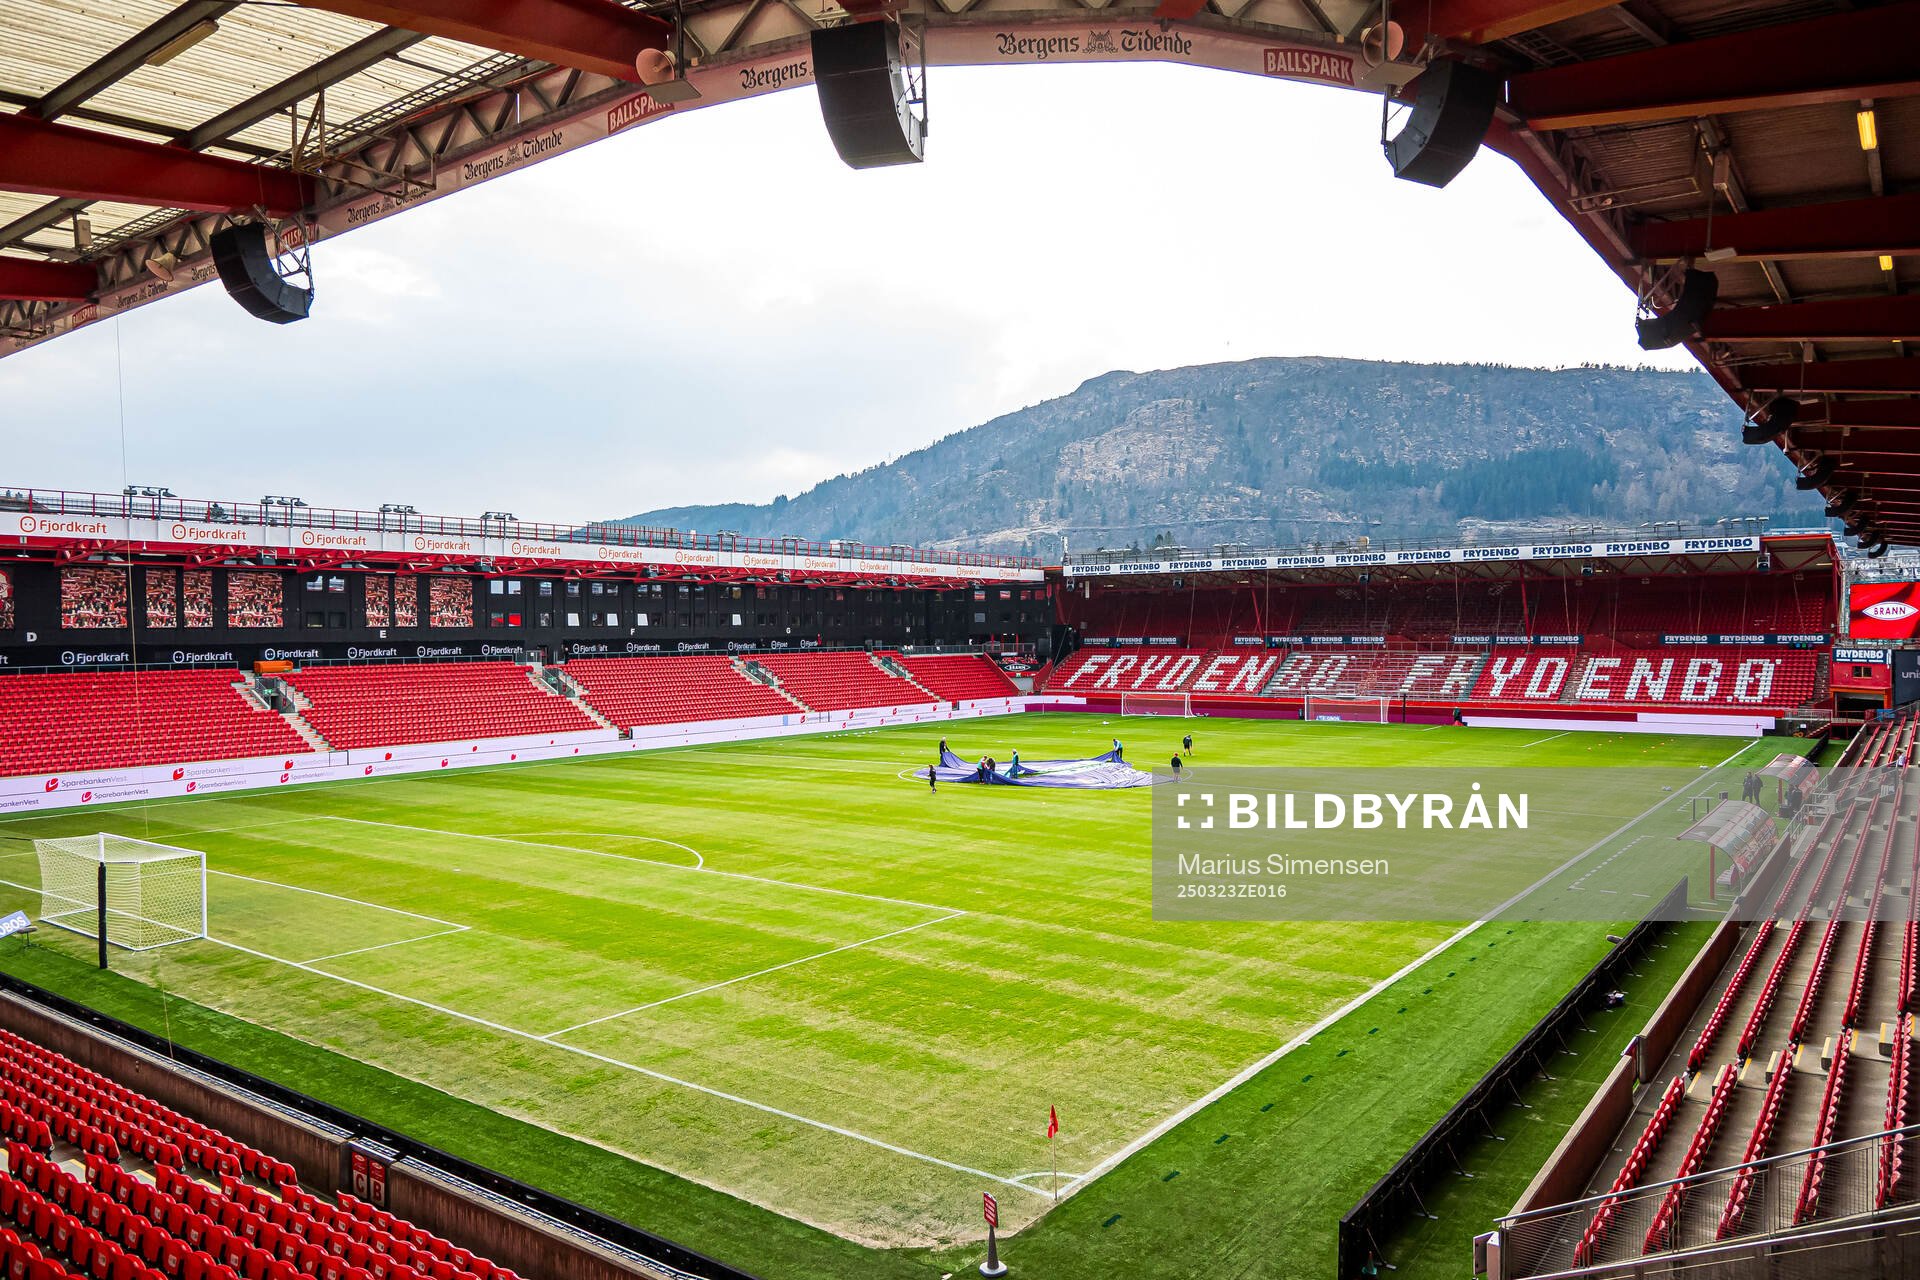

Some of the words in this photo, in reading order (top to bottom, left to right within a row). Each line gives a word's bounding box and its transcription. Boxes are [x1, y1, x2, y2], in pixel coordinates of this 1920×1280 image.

[995, 31, 1080, 60] Bergens
[1120, 29, 1193, 55] Tidende
[1267, 51, 1350, 81] BALLSPARK
[739, 60, 808, 90] Bergens
[463, 154, 504, 180] Bergens
[522, 131, 563, 158] Tidende
[347, 201, 380, 224] Bergens
[40, 520, 107, 535] Fjordkraft
[188, 528, 247, 541] Fjordkraft
[316, 534, 367, 546] Fjordkraft
[427, 541, 471, 551] Fjordkraft
[1606, 541, 1670, 552] FRYDENBØ
[1685, 538, 1753, 549] FRYDENBØ
[522, 545, 561, 555] Fjordkraft
[608, 549, 643, 559] Fjordkraft
[1532, 545, 1593, 556] FRYDENBØ
[684, 554, 715, 563] Fjordkraft
[750, 557, 779, 566] Fjordkraft
[811, 560, 837, 569] Fjordkraft
[865, 562, 890, 571] Fjordkraft
[1873, 606, 1906, 615] BRANN
[26, 632, 38, 642] D
[380, 630, 387, 638] E
[490, 647, 523, 656] Fjordkraft
[633, 643, 660, 652] Fjordkraft
[684, 642, 710, 651] Fjordkraft
[734, 642, 757, 650] Fjordkraft
[186, 652, 233, 663] Fjordkraft
[277, 648, 320, 659] Fjordkraft
[357, 648, 397, 658] Fjordkraft
[427, 647, 462, 657] Fjordkraft
[1836, 649, 1884, 659] FRYDENBØ
[77, 652, 130, 664] Fjordkraft
[61, 775, 127, 788] SparebankenVest
[198, 778, 247, 789] SparebankenVest
[94, 788, 149, 799] SparebankenVest
[356, 1173, 365, 1193] C
[373, 1181, 382, 1201] B
